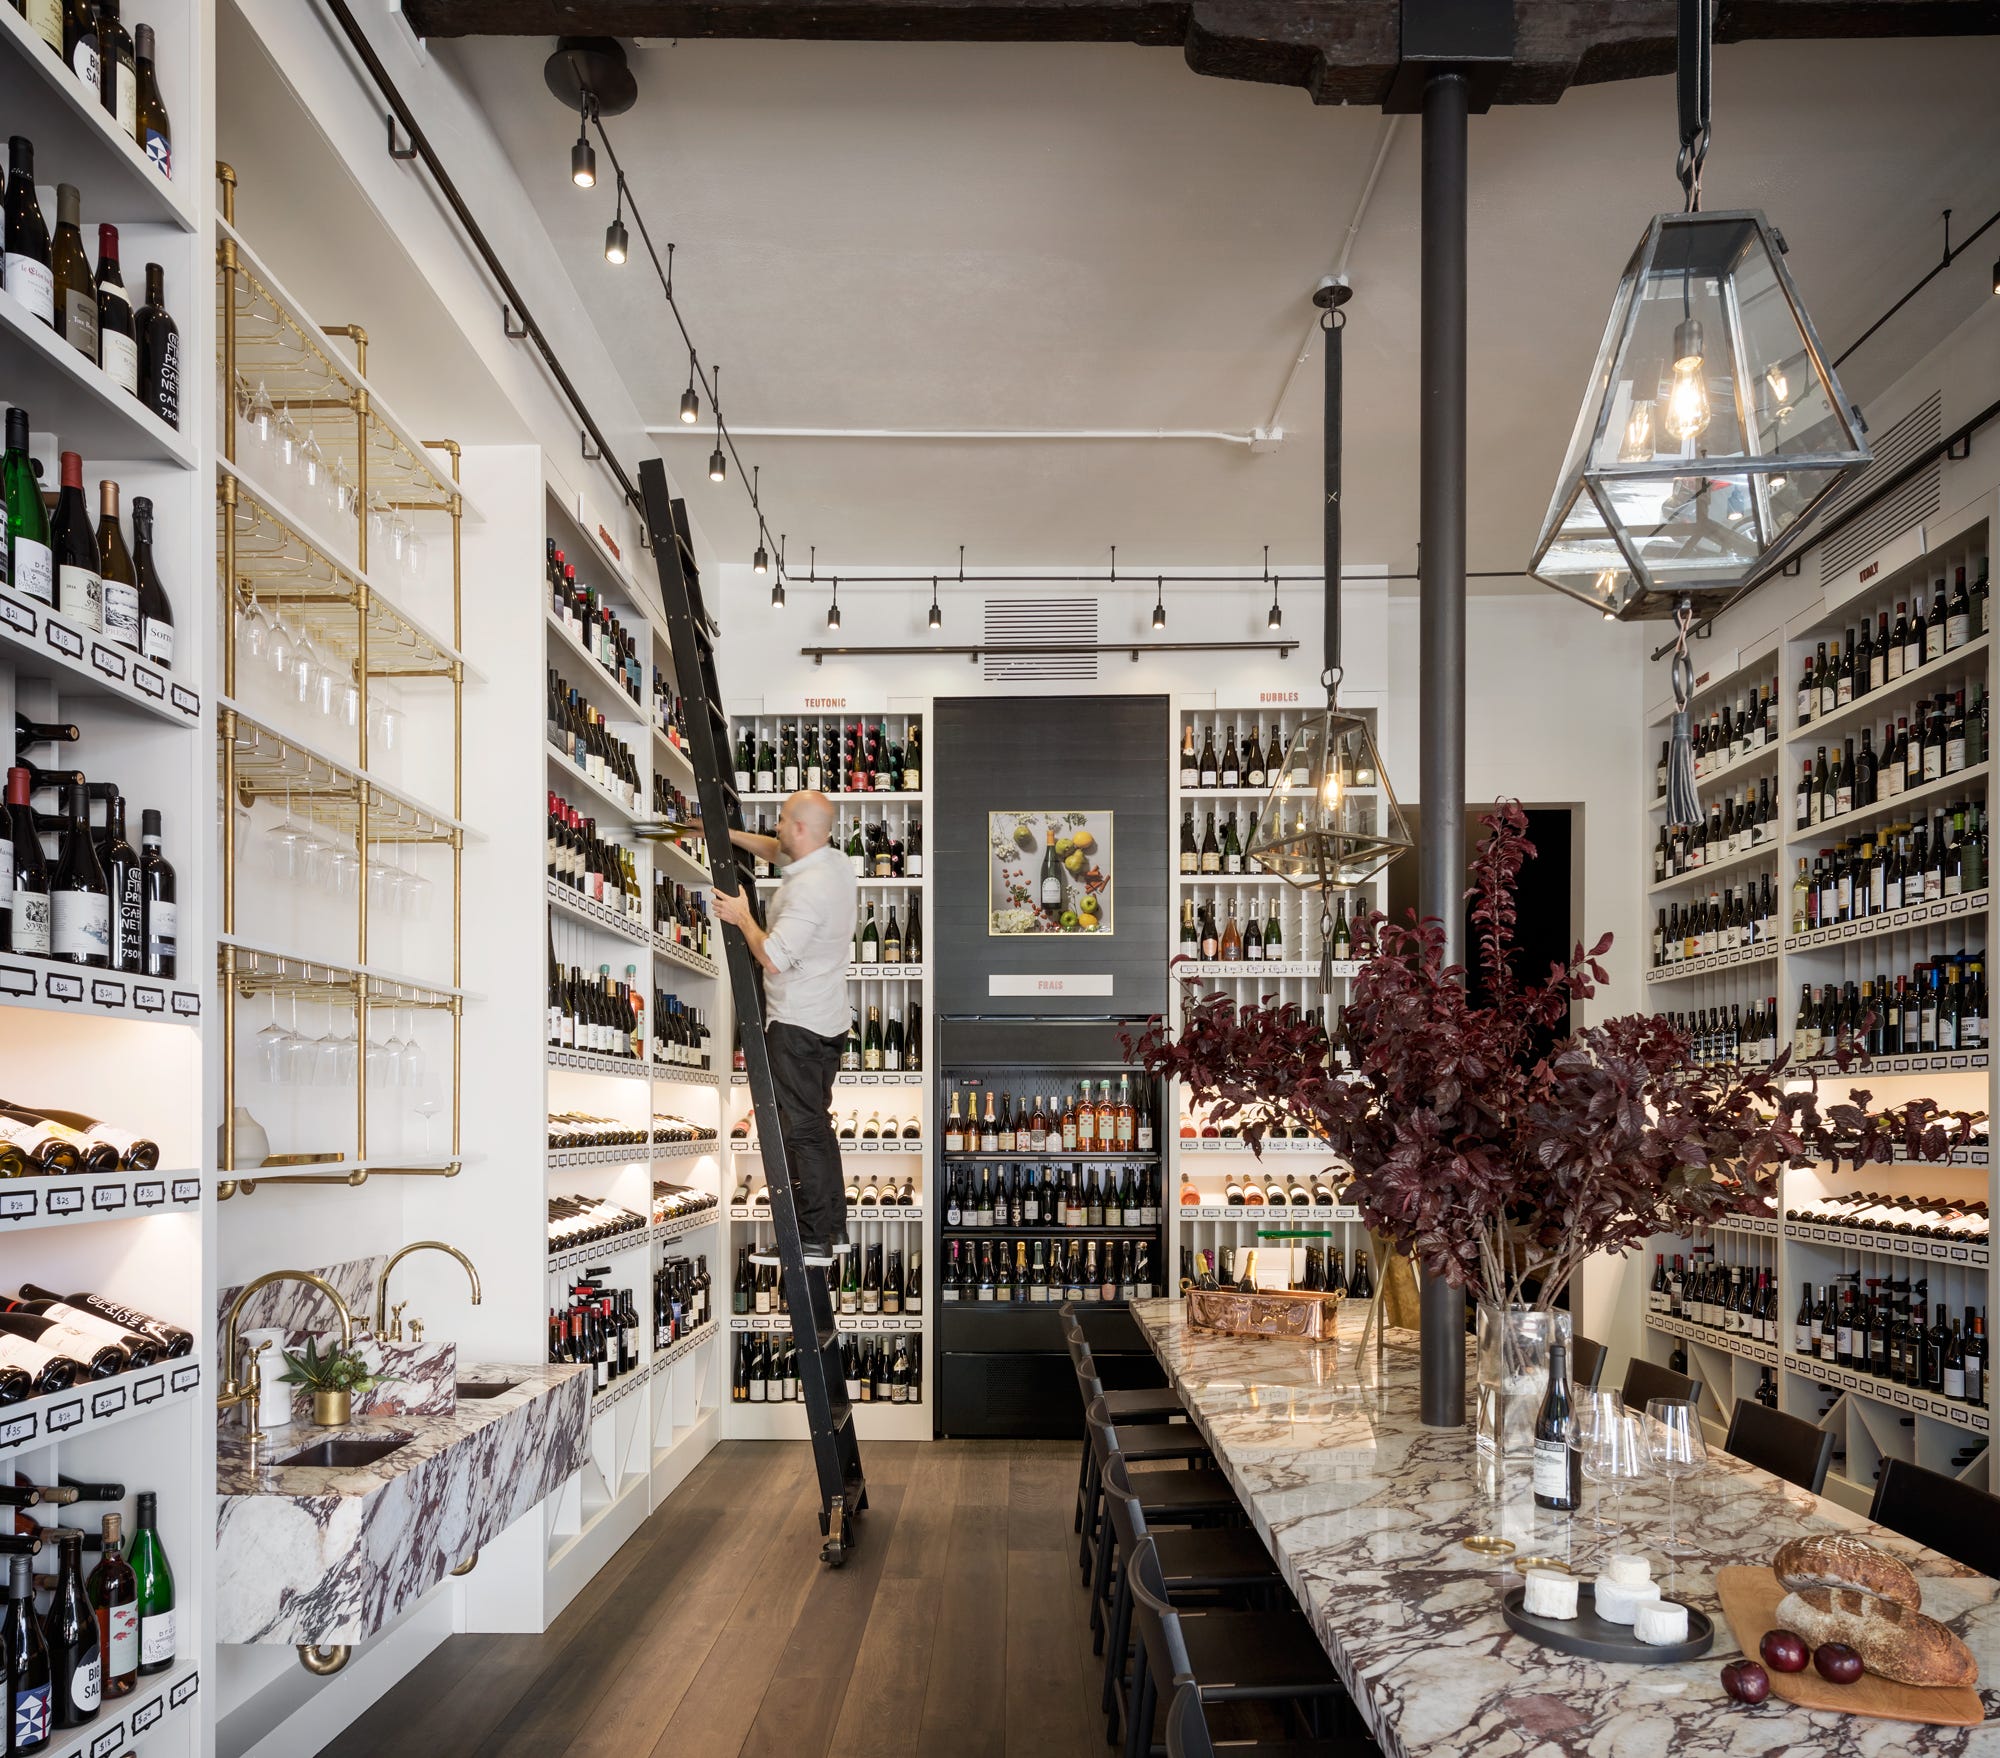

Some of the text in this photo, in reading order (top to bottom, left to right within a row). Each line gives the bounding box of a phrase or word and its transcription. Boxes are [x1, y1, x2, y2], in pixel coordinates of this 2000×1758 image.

[1260, 692, 1299, 702] BUBBLES
[805, 698, 846, 708] TEUTONIC
[1038, 980, 1064, 990] FRAIS
[6, 1423, 21, 1438] $35
